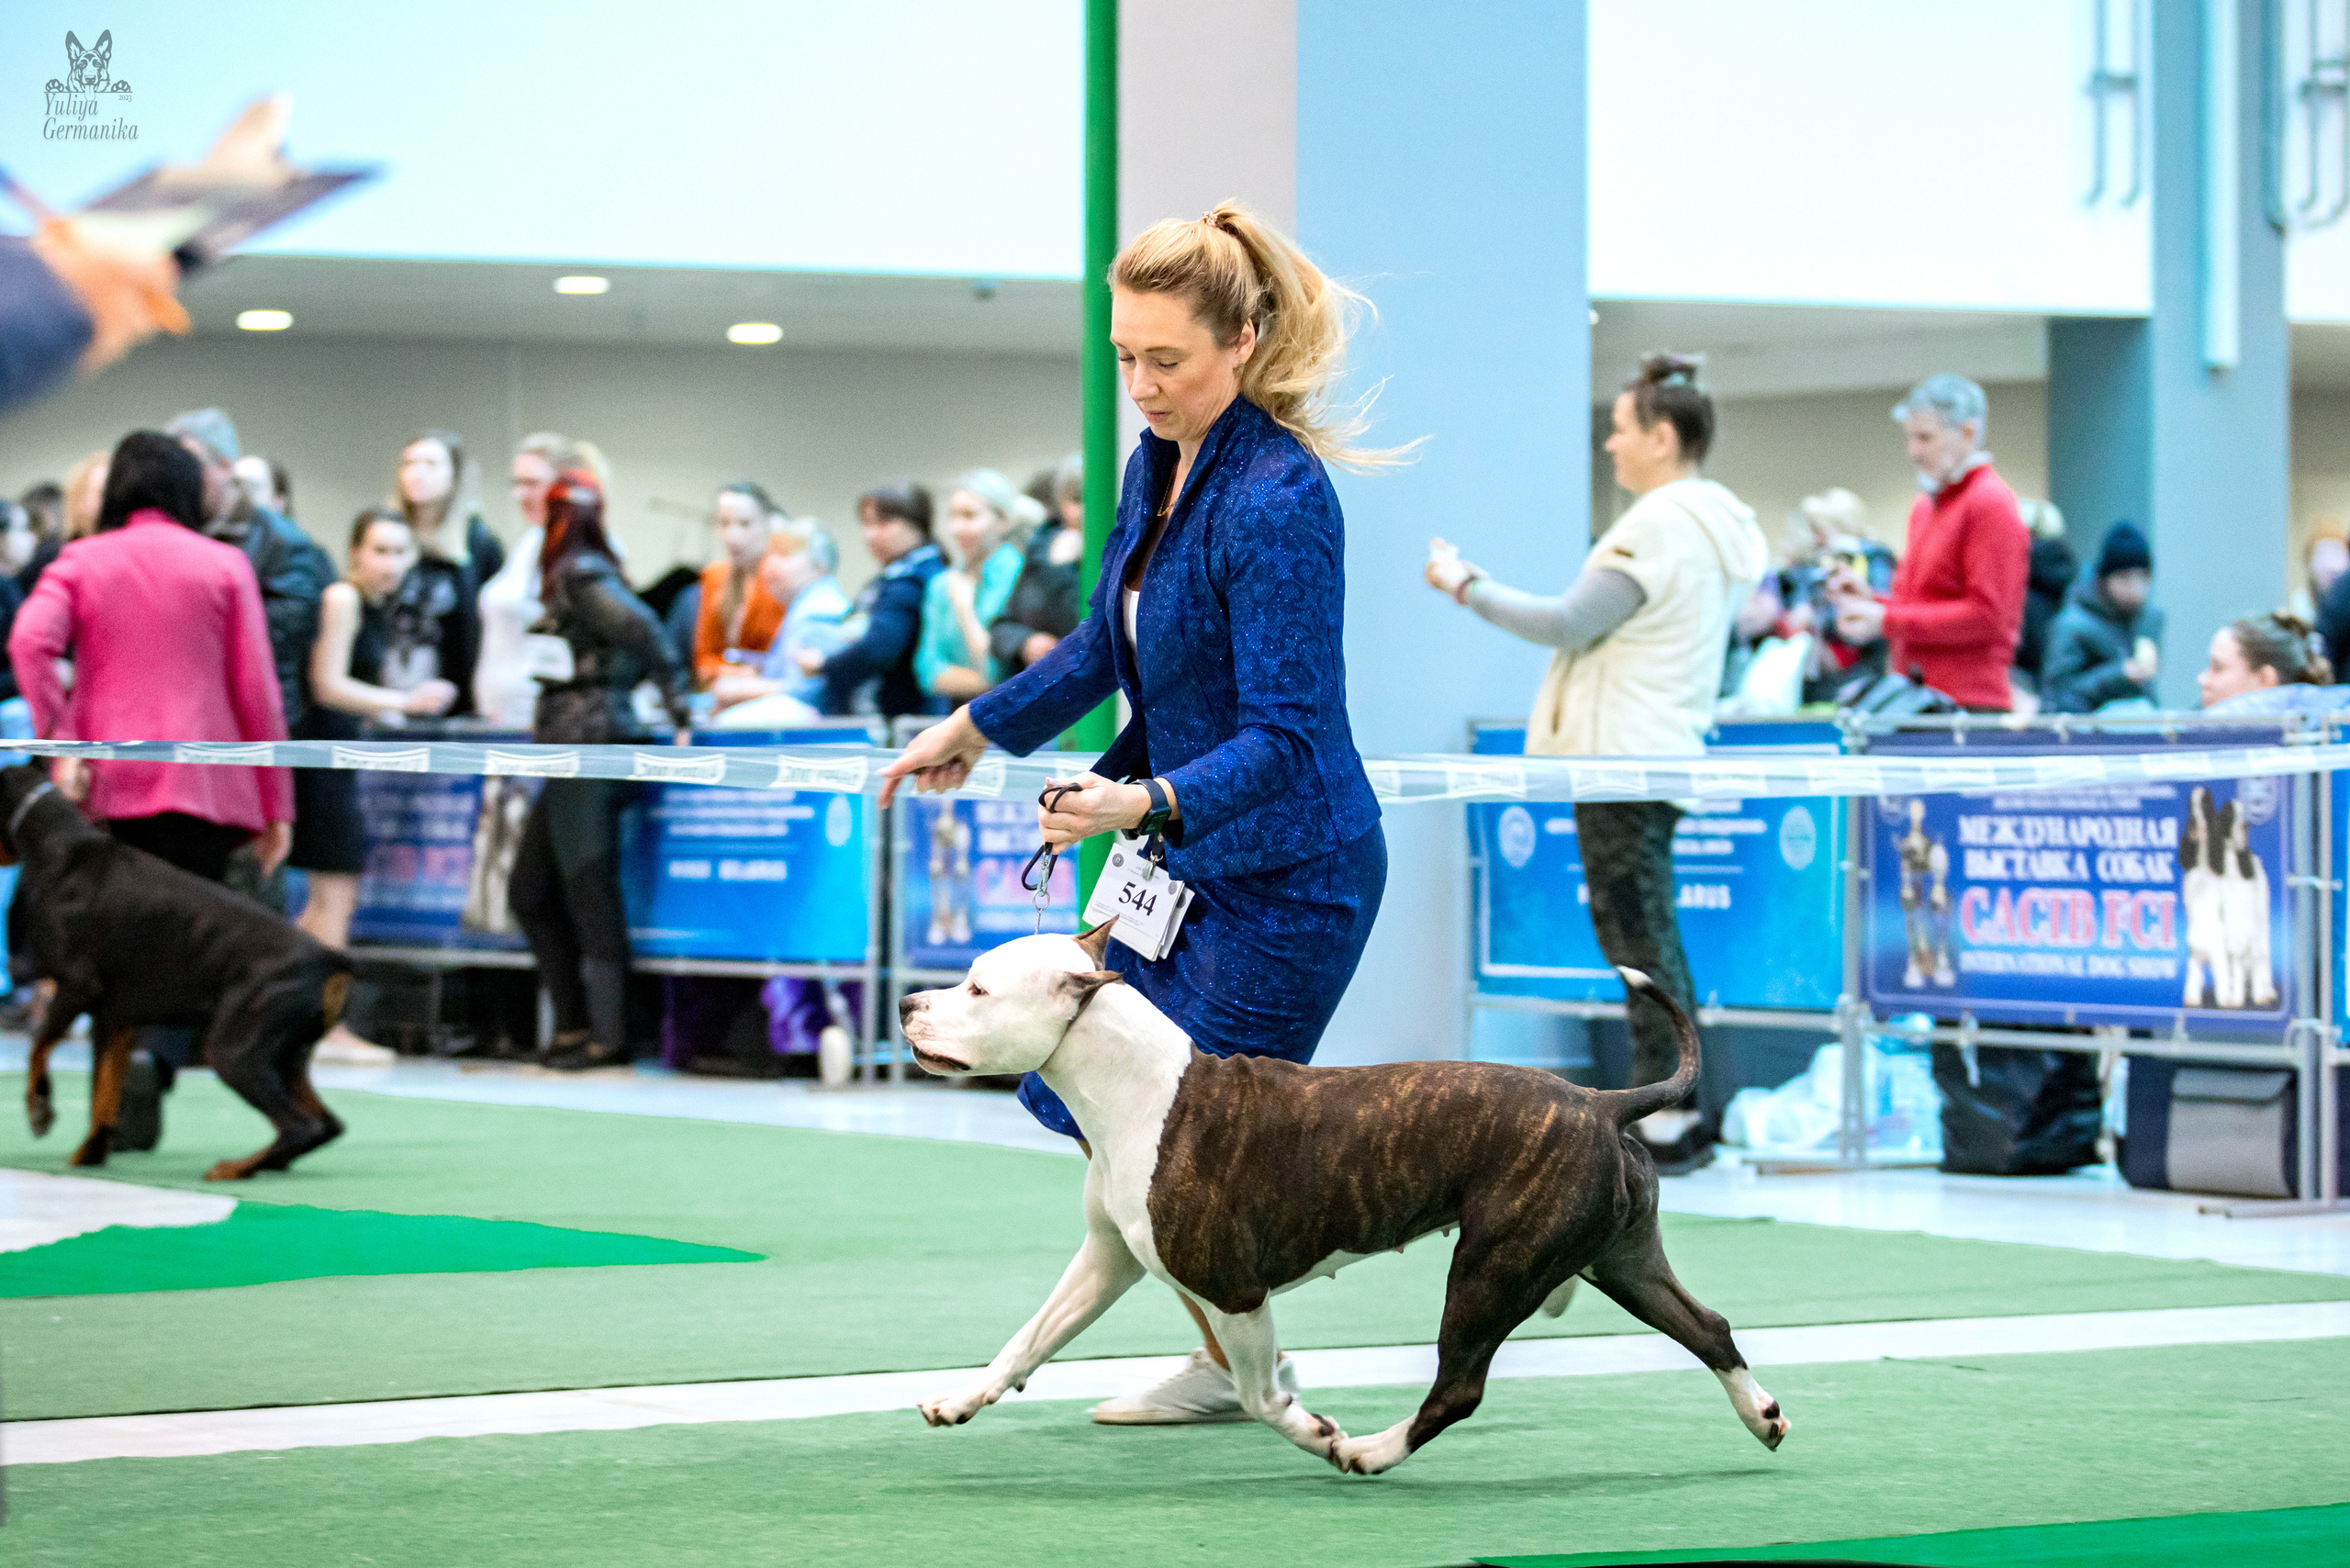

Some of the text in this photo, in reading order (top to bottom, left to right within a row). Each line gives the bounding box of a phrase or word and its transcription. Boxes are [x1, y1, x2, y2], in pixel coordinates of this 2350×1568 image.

[2096, 851, 2176, 883] СОБАК
[1118, 881, 1158, 916] 544
[1960, 887, 2178, 950] CACIB FCI
